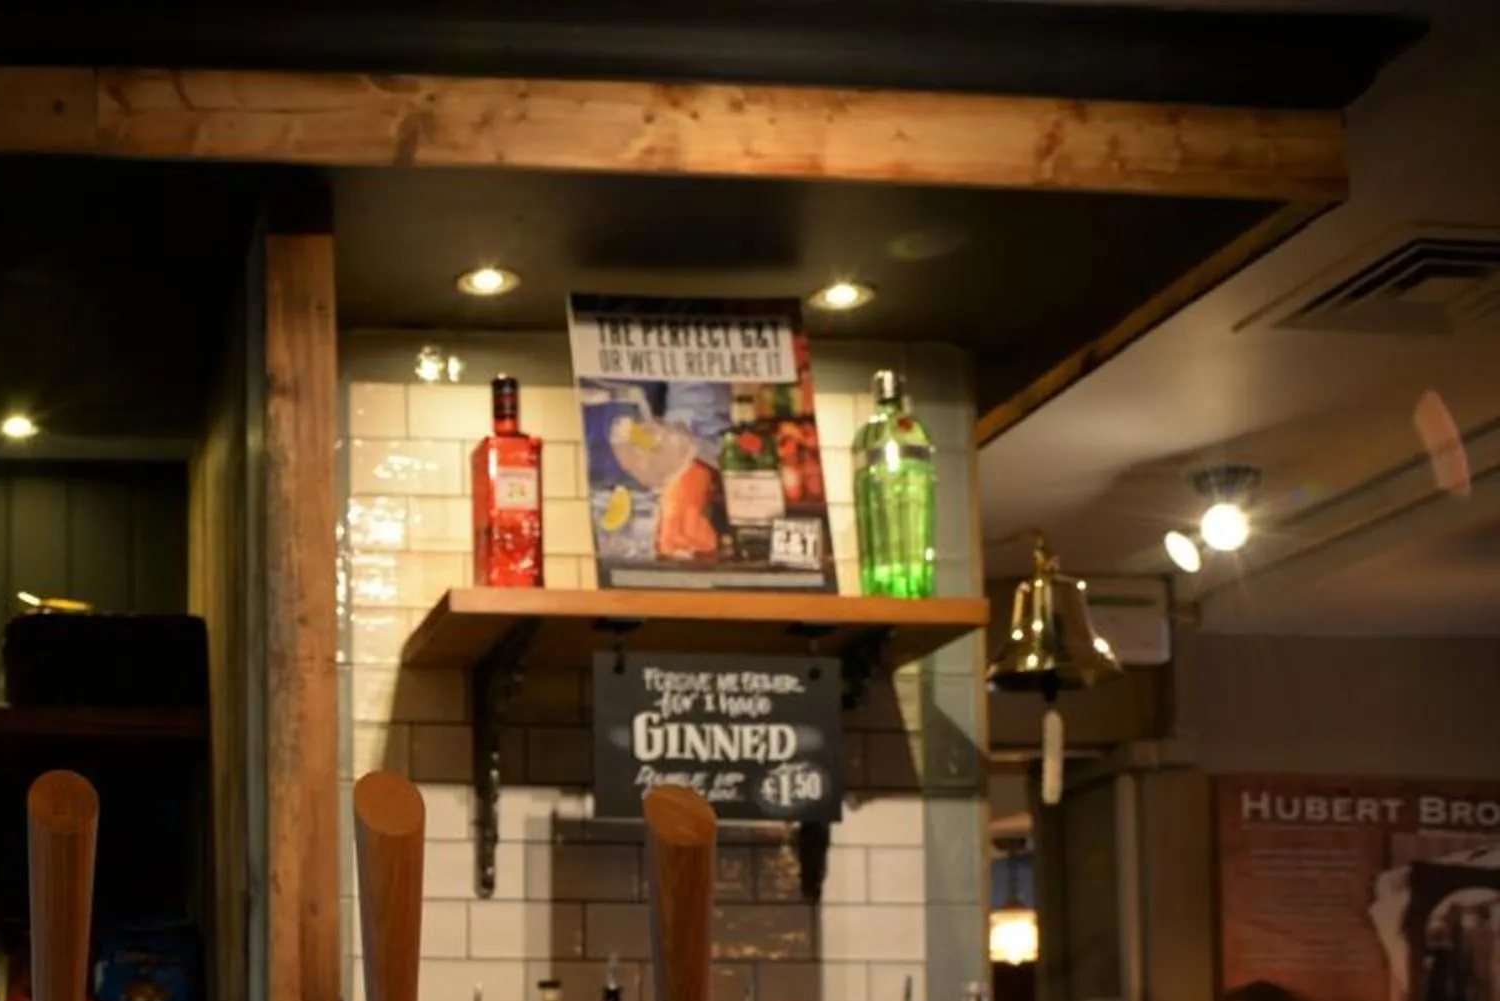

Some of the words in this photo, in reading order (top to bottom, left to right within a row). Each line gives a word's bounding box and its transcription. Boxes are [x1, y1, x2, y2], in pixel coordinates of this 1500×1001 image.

[596, 317, 634, 346] THE
[640, 317, 731, 347] PERFECT
[740, 320, 780, 349] G&T
[599, 349, 622, 373] OR
[627, 351, 679, 376] WE'LL
[684, 352, 760, 377] REPLACE
[767, 353, 782, 377] IT
[633, 711, 797, 763] GINNED
[1241, 791, 1406, 822] HUBERT
[1418, 795, 1500, 826] BRO
